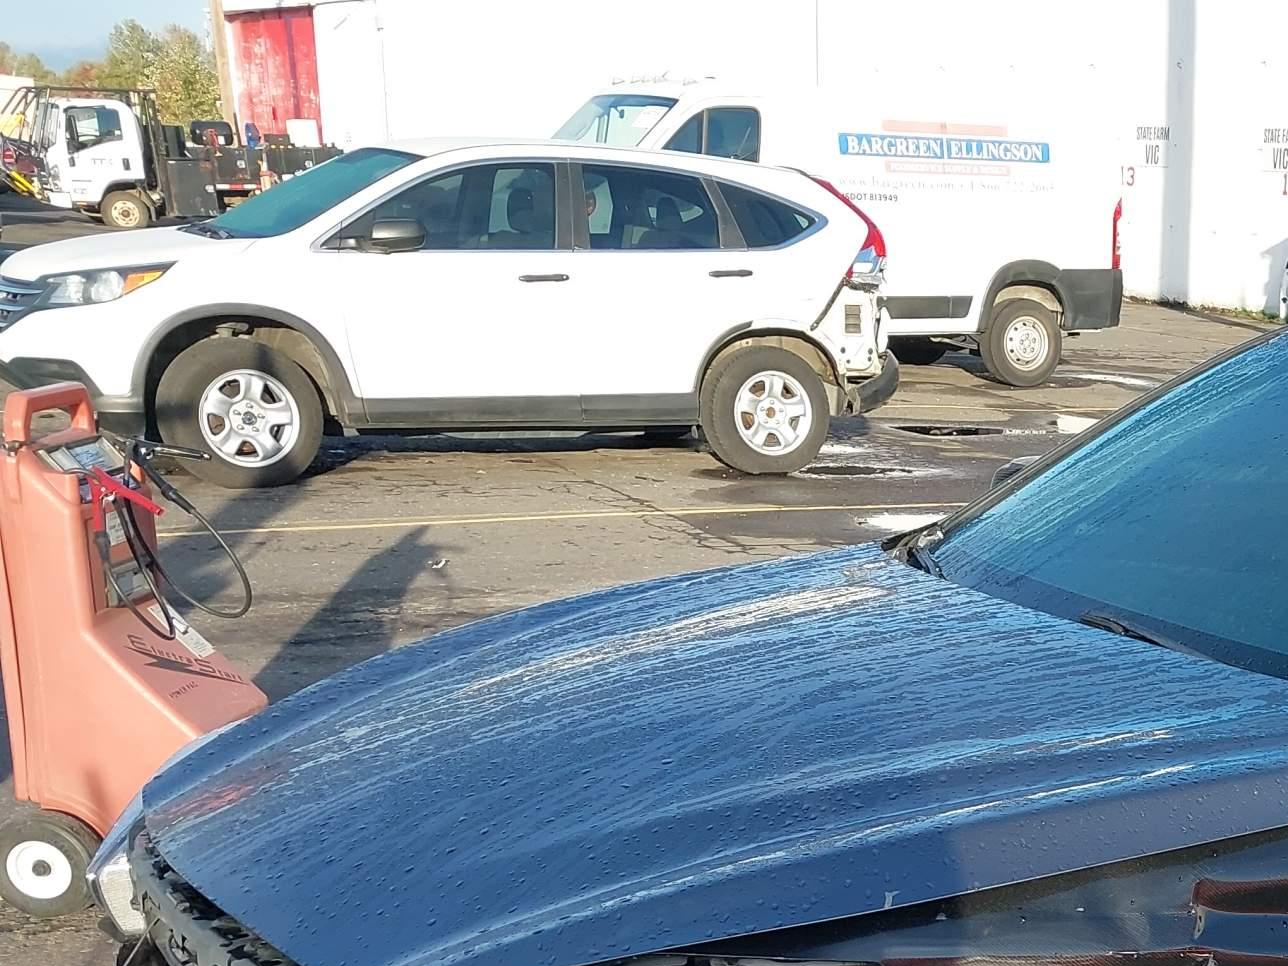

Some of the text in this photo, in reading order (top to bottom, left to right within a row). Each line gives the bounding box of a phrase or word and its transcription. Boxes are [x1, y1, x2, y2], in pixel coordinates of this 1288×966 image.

[1136, 126, 1170, 142] STATE FARM
[1263, 128, 1281, 144] STATE
[846, 135, 1044, 161] BARGREEN ELLINGSON
[1145, 144, 1160, 165] VIC
[1272, 147, 1288, 170] VIC
[1120, 165, 1136, 187] 13
[869, 193, 899, 203] 813949
